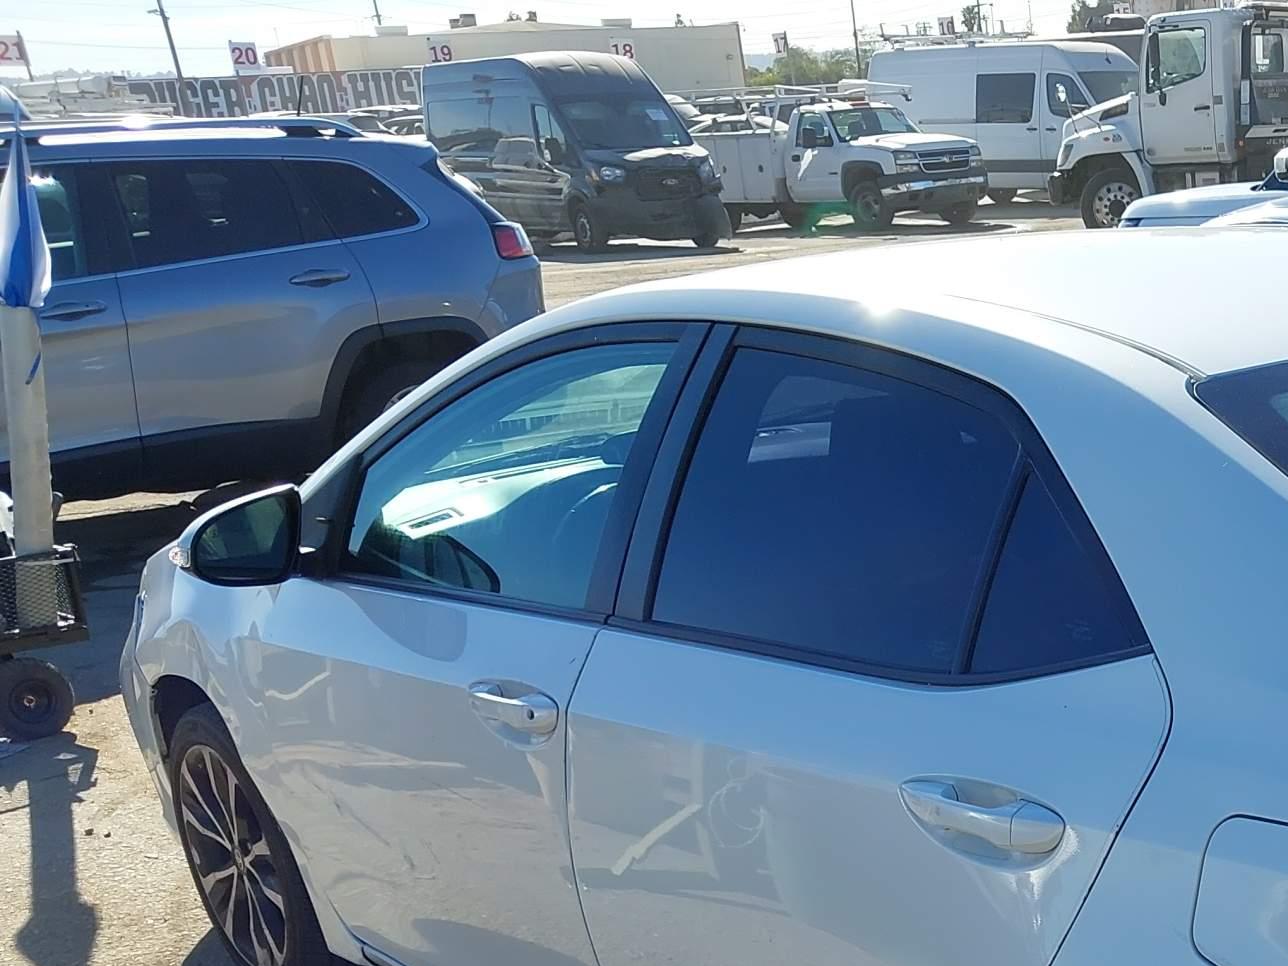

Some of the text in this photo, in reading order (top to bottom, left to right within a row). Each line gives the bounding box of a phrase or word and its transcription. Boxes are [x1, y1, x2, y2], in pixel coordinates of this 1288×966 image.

[231, 46, 258, 65] 20
[429, 44, 453, 63] 19
[611, 43, 634, 59] 18
